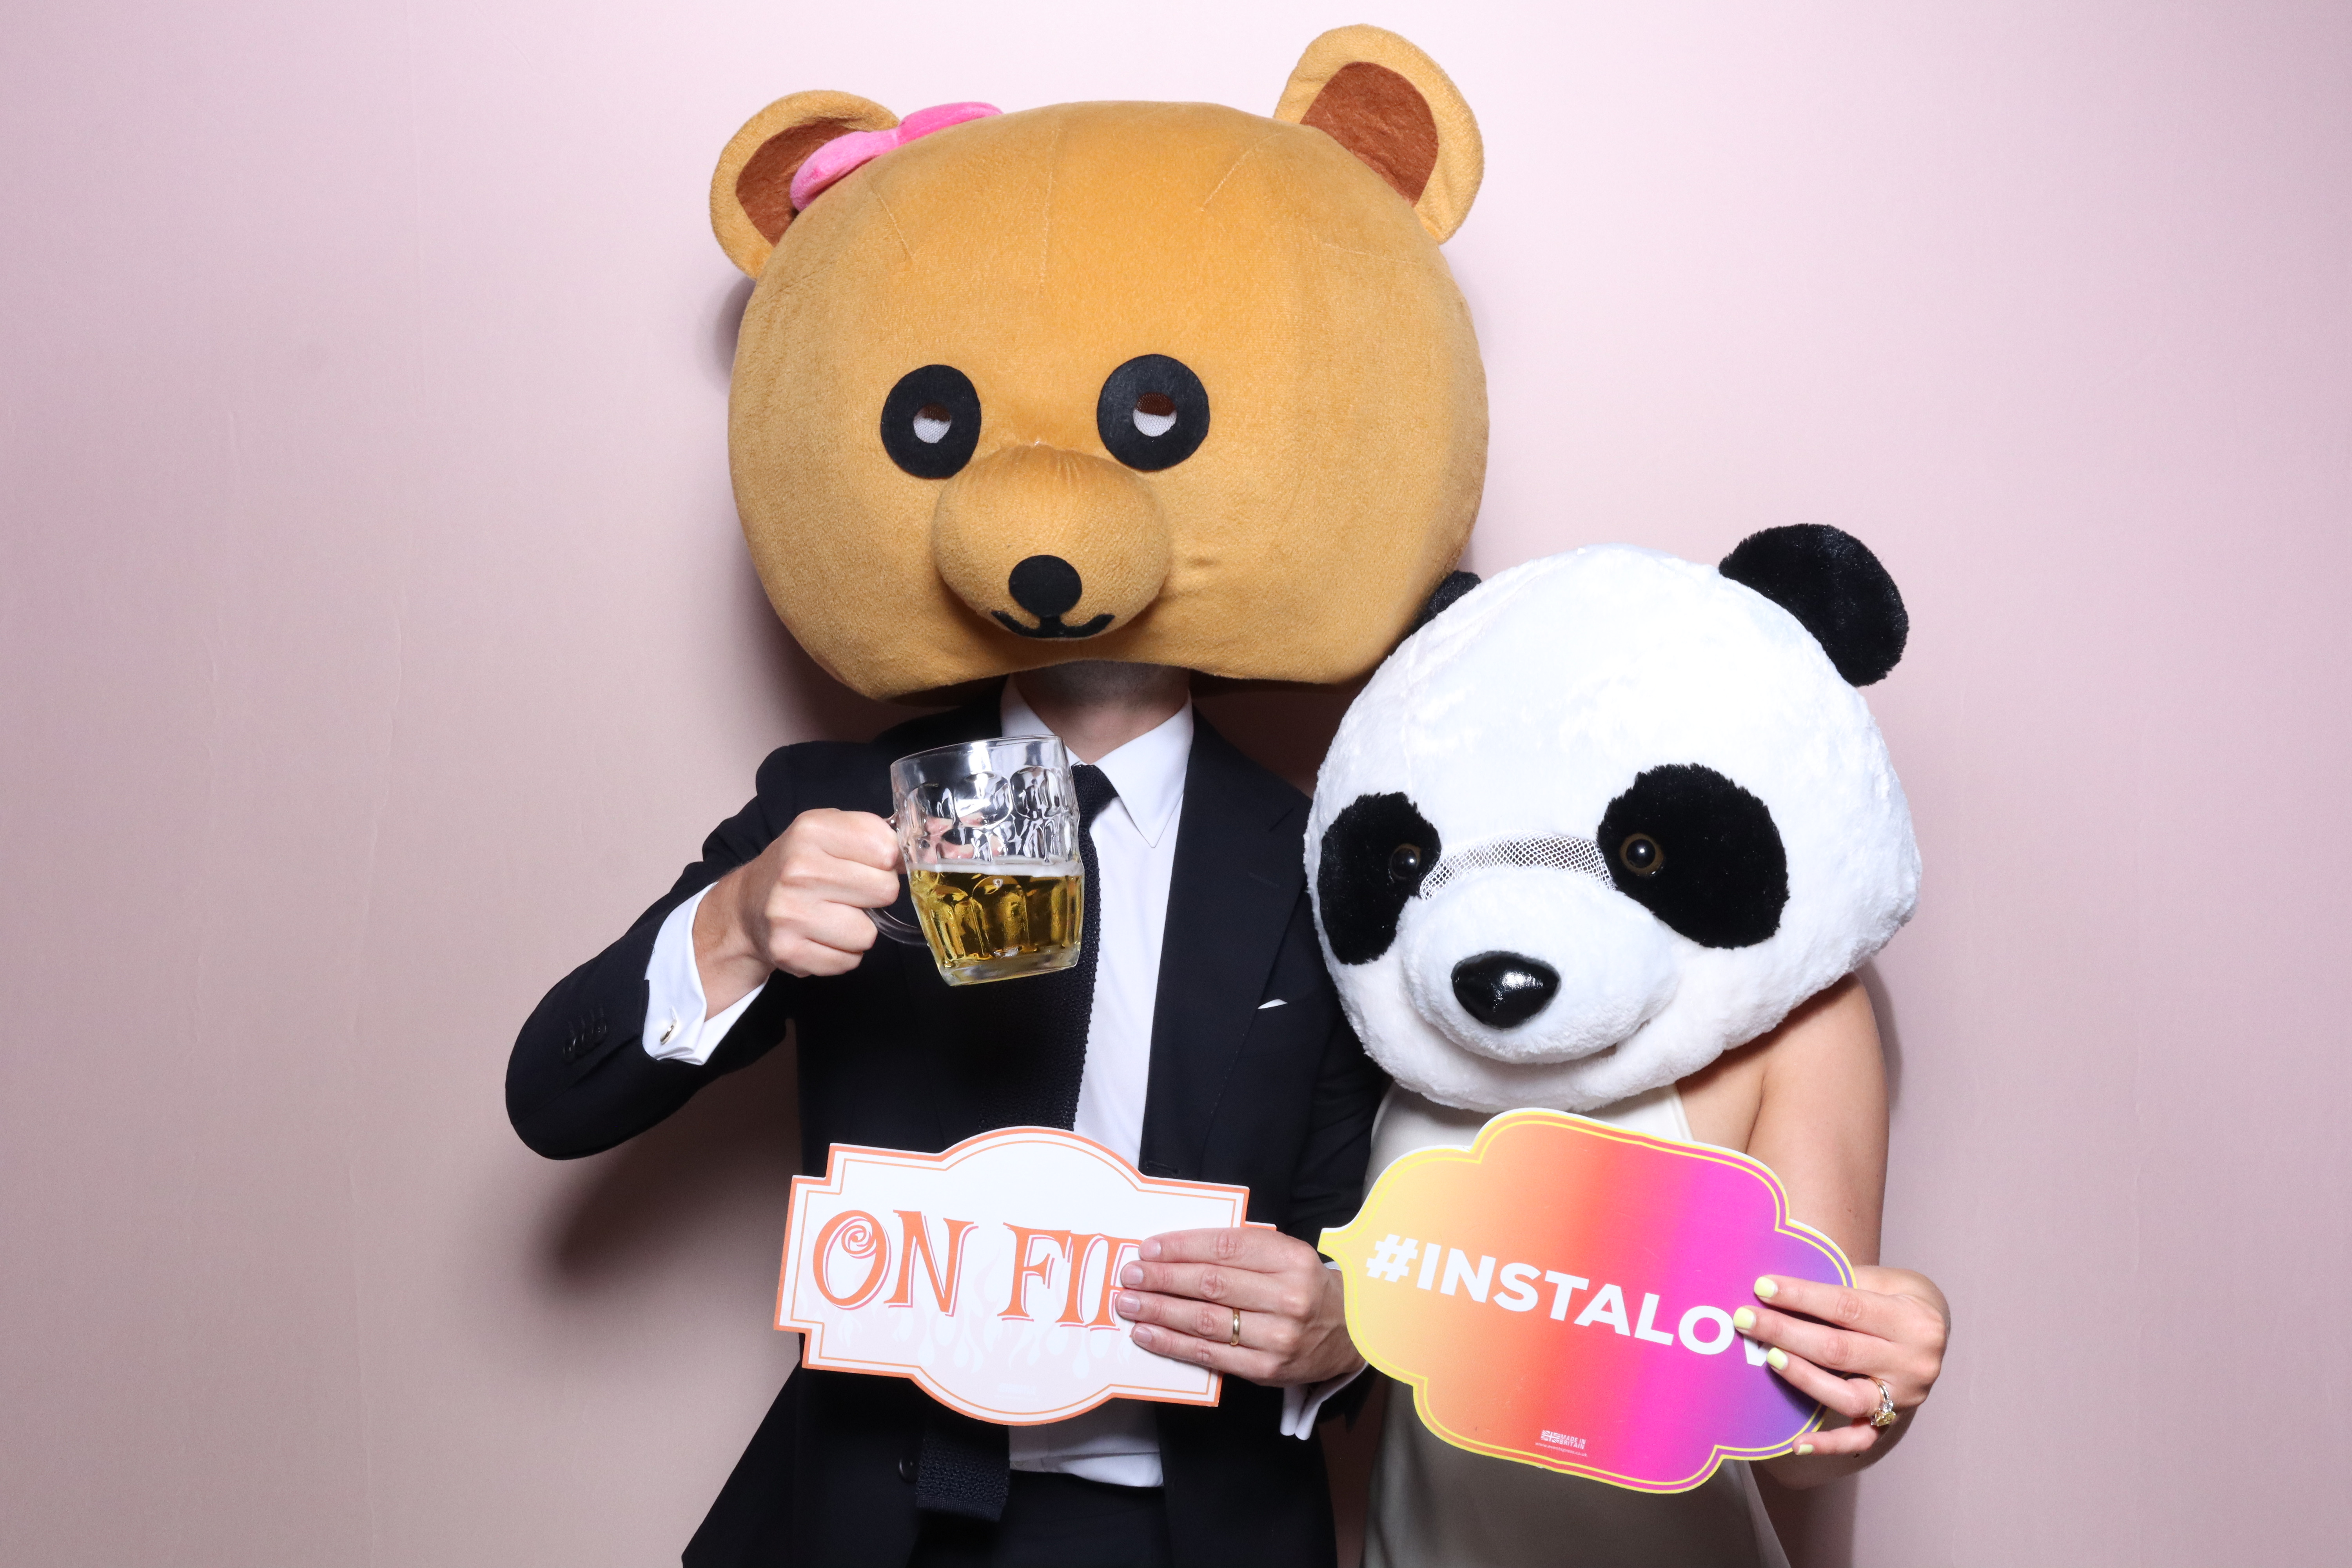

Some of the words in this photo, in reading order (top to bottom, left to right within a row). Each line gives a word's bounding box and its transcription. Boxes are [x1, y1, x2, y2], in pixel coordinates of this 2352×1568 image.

[813, 1210, 979, 1316] ON
[1366, 1234, 1768, 1367] #INSTALO
[1559, 1439, 1585, 1450] BRITAIN
[1560, 1434, 1578, 1443] MADE
